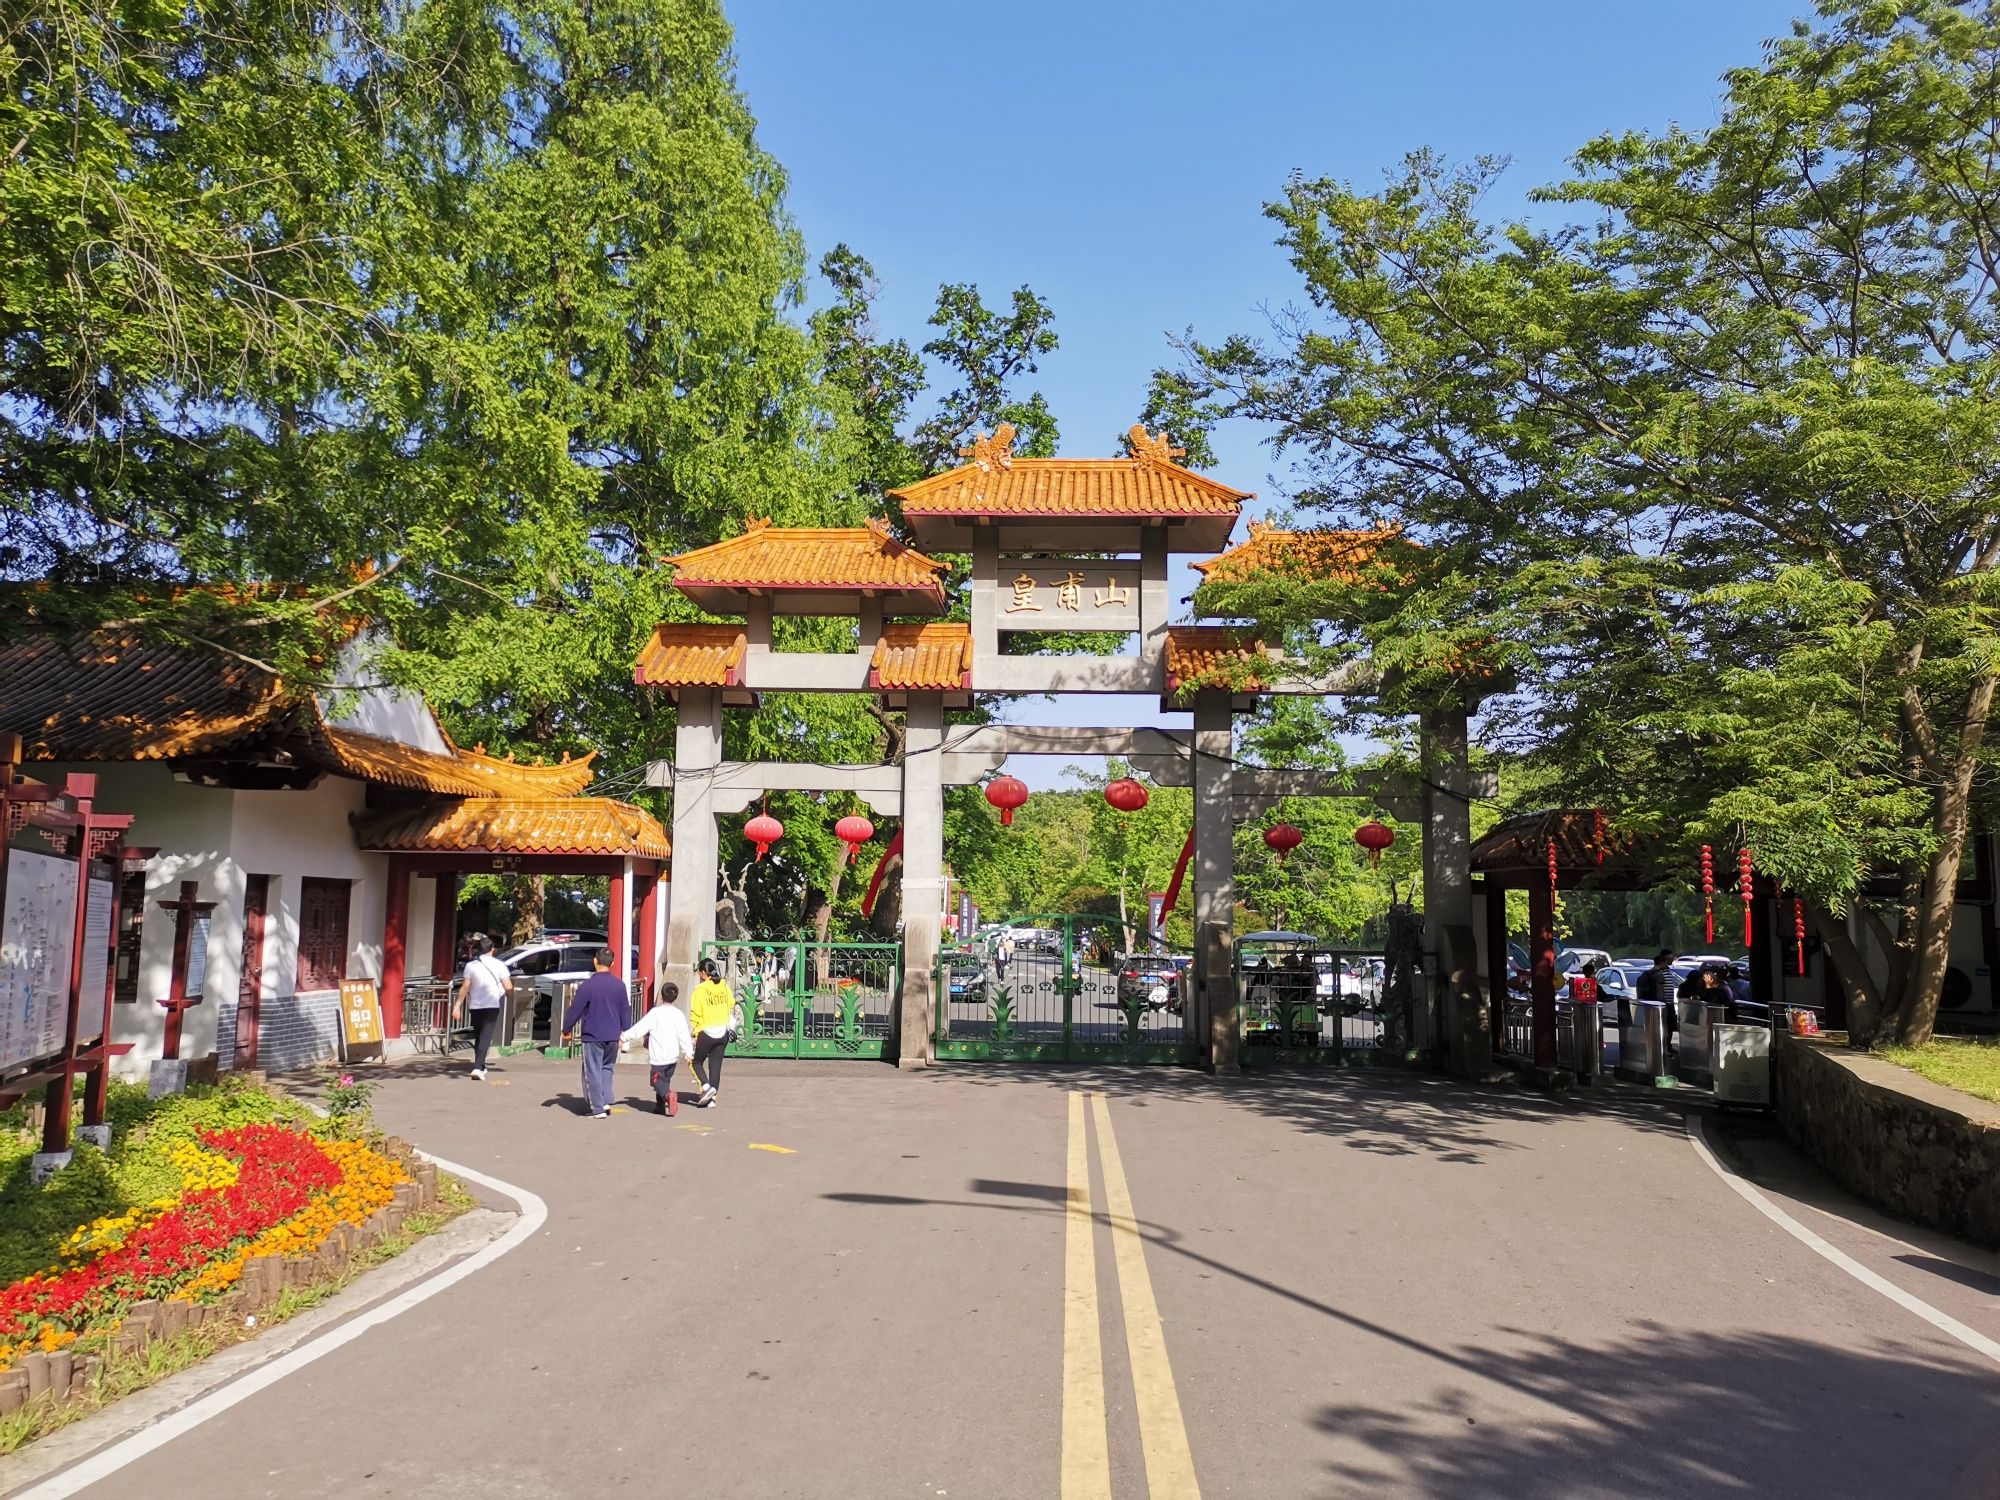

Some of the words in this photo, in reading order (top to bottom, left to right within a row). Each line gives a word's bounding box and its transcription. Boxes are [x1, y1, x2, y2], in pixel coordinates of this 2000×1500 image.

[1005, 571, 1130, 613] 皇甫山
[350, 1009, 371, 1022] 出口
